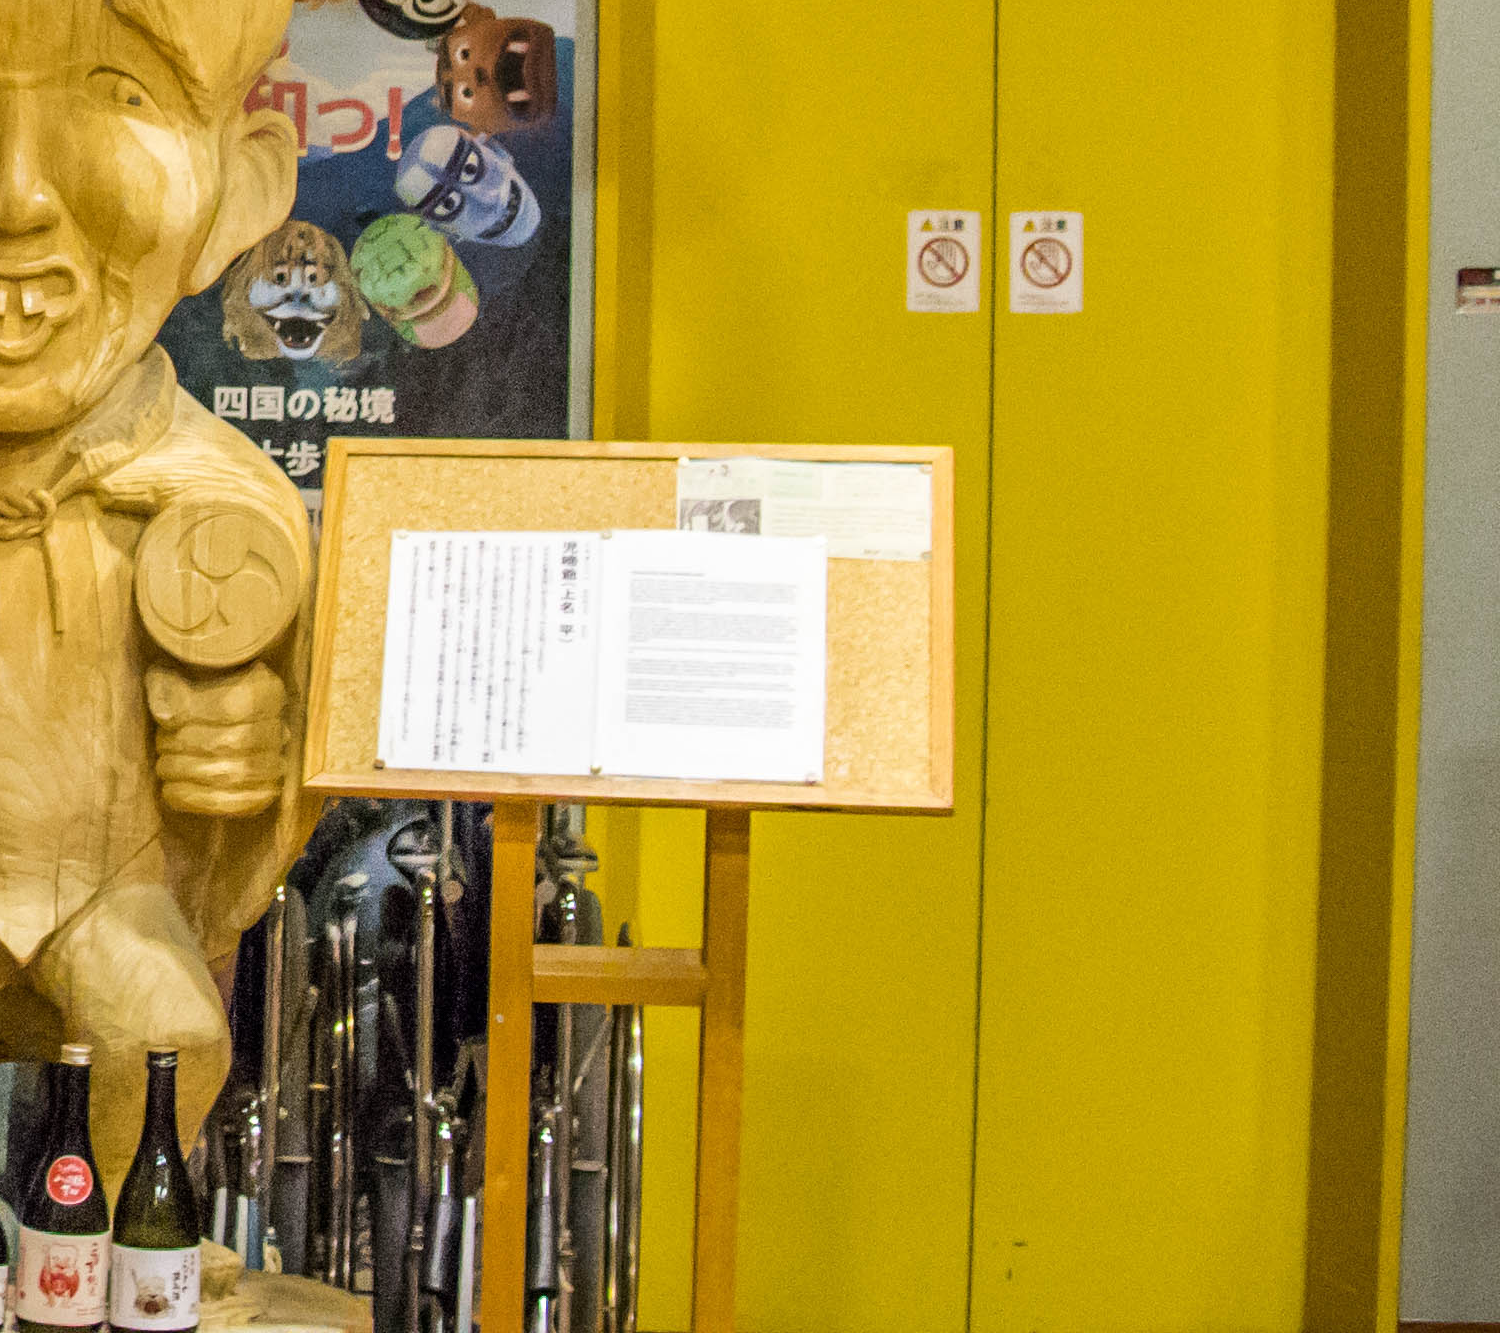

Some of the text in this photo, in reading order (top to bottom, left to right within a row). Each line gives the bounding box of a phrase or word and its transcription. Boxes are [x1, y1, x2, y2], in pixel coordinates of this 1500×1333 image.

[213, 385, 396, 424] 四国の秘境
